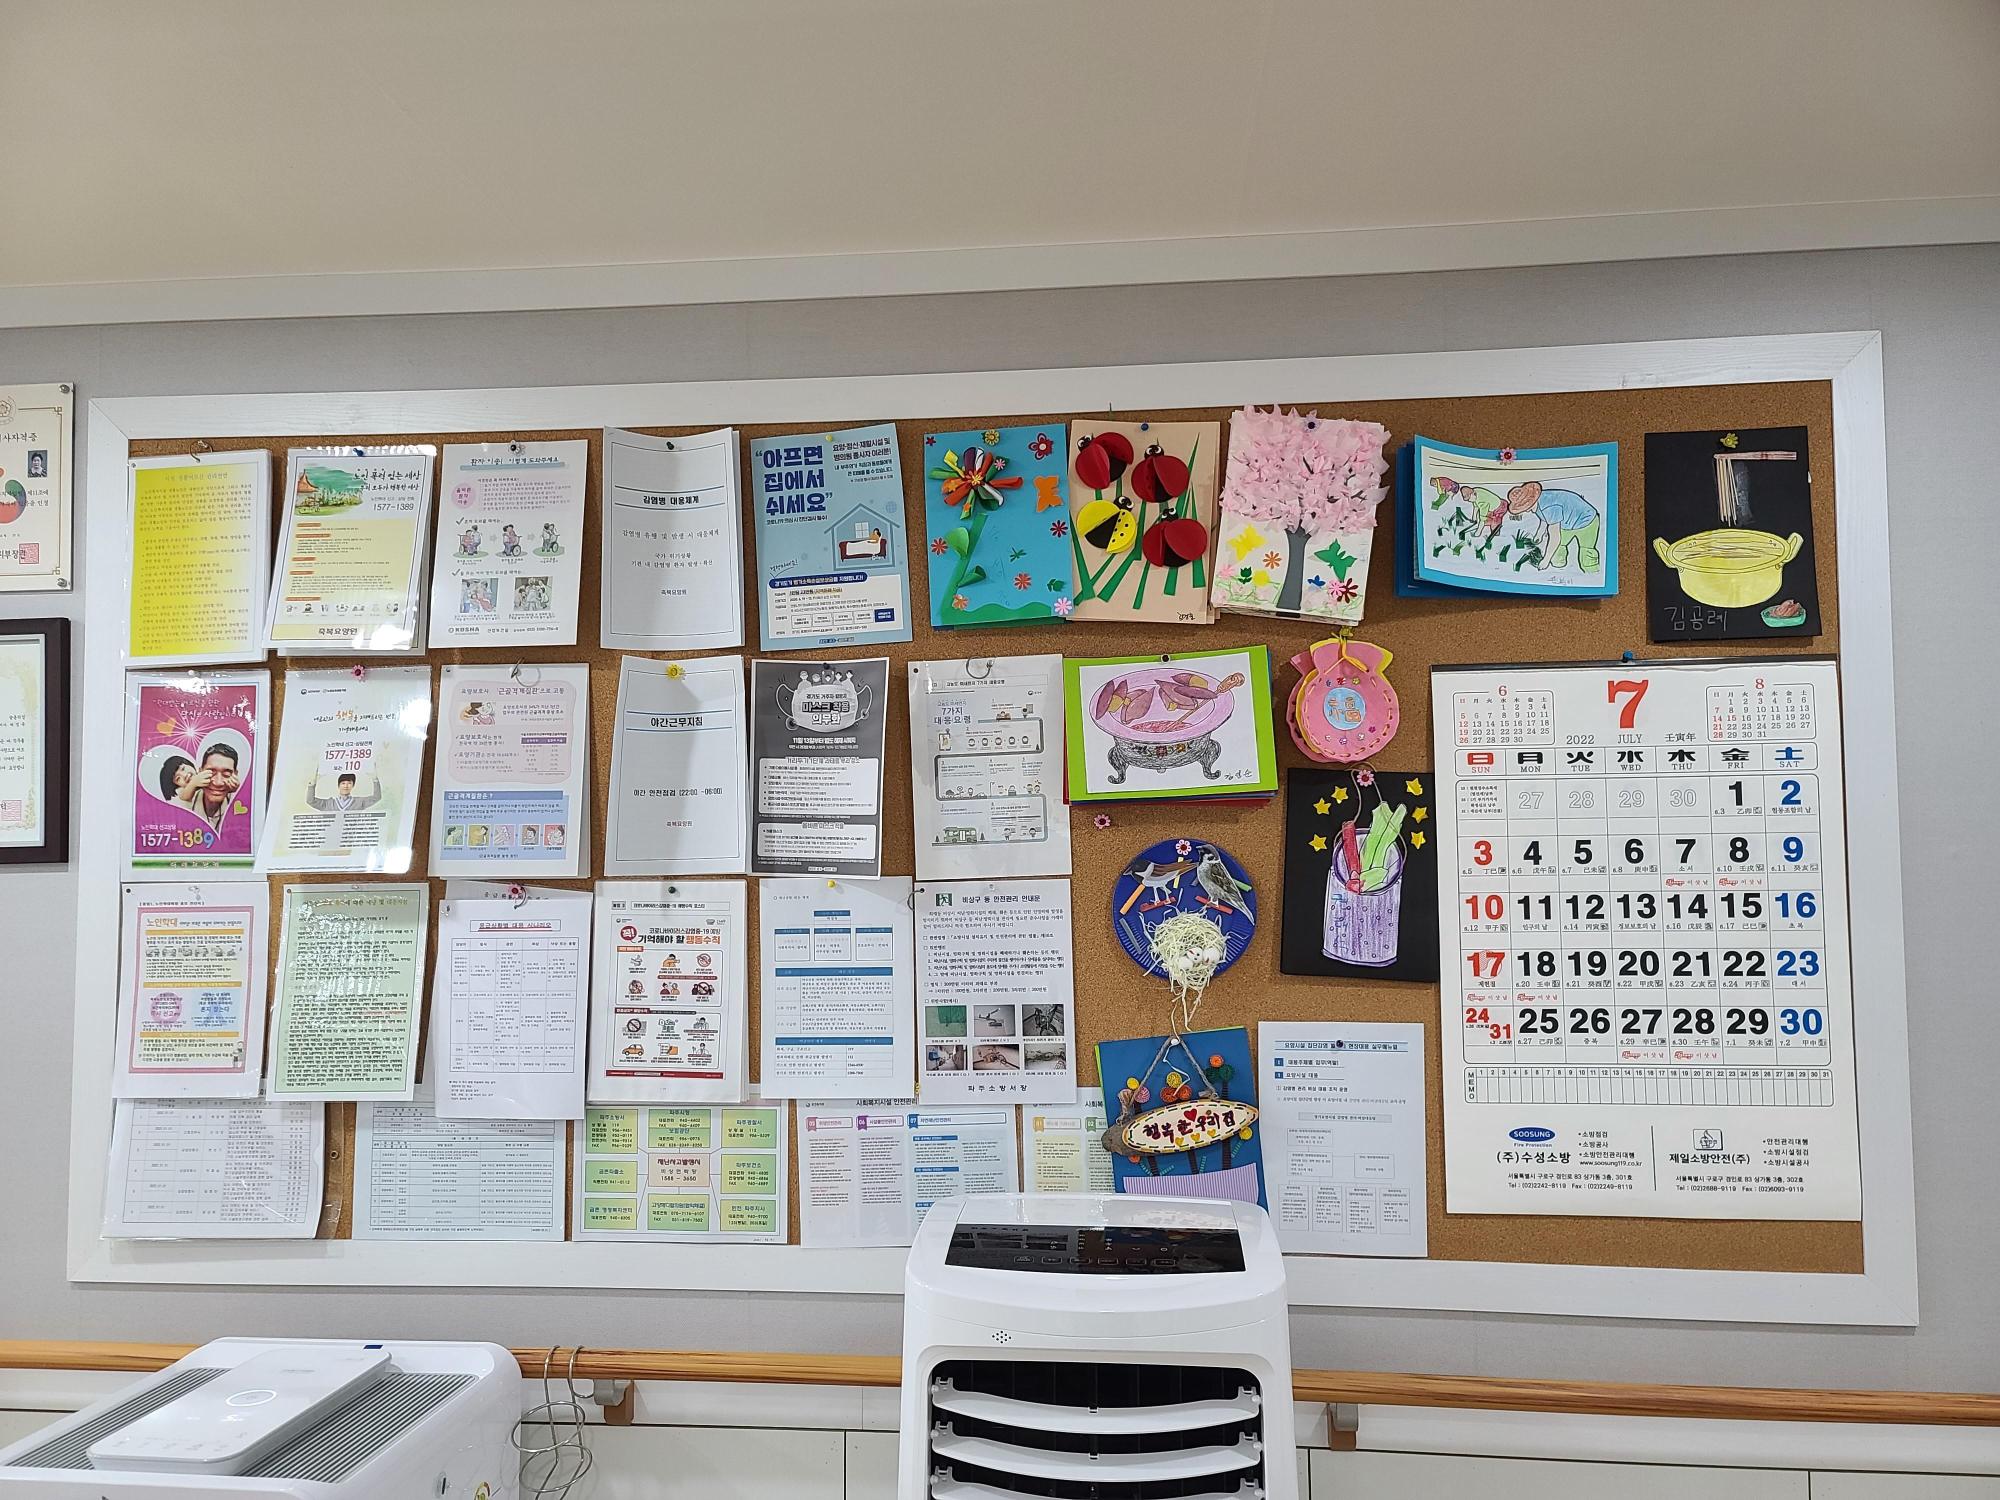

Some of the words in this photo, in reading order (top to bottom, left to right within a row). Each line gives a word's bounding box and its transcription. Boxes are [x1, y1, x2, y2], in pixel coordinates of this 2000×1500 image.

[354, 469, 369, 480] 노인
[405, 470, 422, 480] 세상
[764, 469, 825, 492] 집에서
[643, 495, 666, 505] 감염병
[670, 495, 699, 505] 대응체계
[1756, 679, 1764, 689] 8
[1499, 686, 1507, 696] 6
[802, 702, 831, 712] 마스크
[832, 701, 850, 712] 착용
[1608, 680, 1649, 729] 7
[942, 707, 963, 715] 7가지
[651, 717, 703, 728] 야간근무지침
[812, 712, 841, 725] 의무화
[934, 716, 971, 725] 대응요령
[1566, 735, 1595, 744] 2022
[1618, 734, 1642, 744] JULY
[1665, 733, 1696, 742] 壬寅年
[325, 749, 371, 760] 1577-1389
[1467, 753, 1494, 765] 日
[1518, 752, 1543, 764] 月
[1567, 751, 1593, 764] 火
[1617, 751, 1644, 763] 水
[1667, 749, 1696, 762] 木
[1721, 748, 1749, 761] 金
[1774, 747, 1804, 760] 土
[345, 761, 360, 771] 110
[1519, 792, 1544, 809] 27
[1569, 791, 1594, 808] 28
[1619, 790, 1645, 808] 29
[1670, 789, 1697, 807] 30
[1729, 781, 1743, 806] 1
[1781, 780, 1801, 805] 2
[141, 829, 215, 849] 1577-1389
[1474, 840, 1493, 865] 3
[1524, 841, 1542, 865] 4
[1574, 840, 1593, 865] 5
[1624, 838, 1644, 864] 6
[1675, 839, 1696, 864] 7
[1729, 837, 1749, 863] 8
[1783, 837, 1804, 863] 9
[1465, 895, 1503, 920] 10
[1517, 895, 1551, 920] 11
[1566, 895, 1605, 920] 12
[1617, 893, 1656, 919] 13
[1667, 894, 1708, 919] 14
[1721, 892, 1762, 918] 15
[1775, 892, 1816, 918] 16
[147, 918, 177, 927] 노인학대
[638, 935, 673, 944] 기억해야
[676, 935, 684, 944] 할
[686, 935, 720, 944] 행동수칙
[1467, 952, 1506, 977] 17
[1517, 951, 1556, 976] 18
[1568, 951, 1607, 976] 19
[1618, 951, 1660, 976] 20
[1672, 951, 1710, 976] 21
[1723, 951, 1766, 976] 22
[1777, 951, 1819, 976] 23
[1466, 1008, 1489, 1023] 24
[1489, 1024, 1511, 1040] 31
[1519, 1008, 1559, 1034] 25
[1570, 1008, 1610, 1034] 26
[1621, 1009, 1662, 1035] 27
[1673, 1008, 1715, 1035] 28
[1726, 1008, 1769, 1035] 29
[1780, 1009, 1823, 1035] 30
[1496, 1152, 1571, 1164] (주)수성소방
[1669, 1153, 1750, 1164] 제일소방안전(주)
